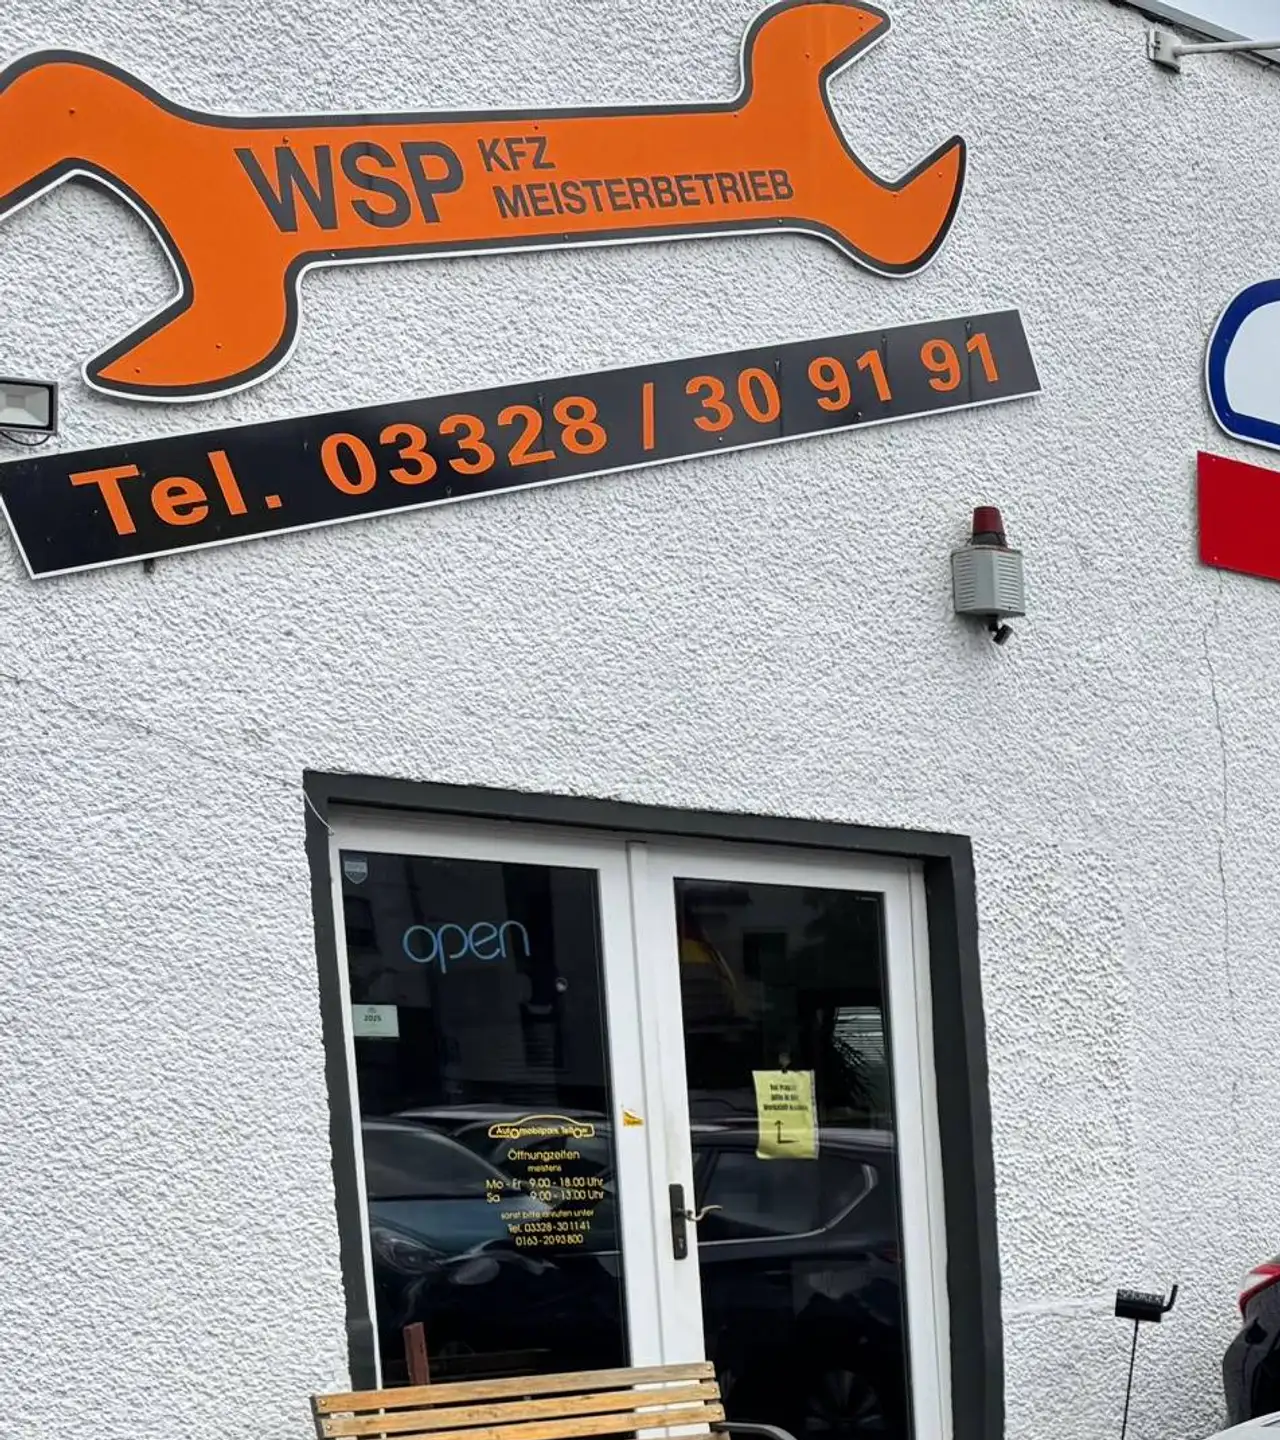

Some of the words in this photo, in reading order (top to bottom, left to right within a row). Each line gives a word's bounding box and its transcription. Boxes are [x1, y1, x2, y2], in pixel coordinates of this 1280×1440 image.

[478, 135, 555, 174] KFZ
[234, 140, 464, 235] WSP
[493, 168, 795, 220] MEISTERBETRIEB
[69, 450, 283, 537] Tel.
[320, 393, 608, 497] 03328
[641, 381, 657, 450] /
[684, 366, 783, 433] 30
[807, 347, 891, 413] 91
[918, 332, 1002, 392] 91
[403, 918, 531, 974] open
[485, 1179, 504, 1189] Mo
[560, 1177, 585, 1187] 18.00
[587, 1176, 604, 1187] Uhr
[486, 1193, 500, 1203] Sa
[588, 1189, 604, 1199] Uhr
